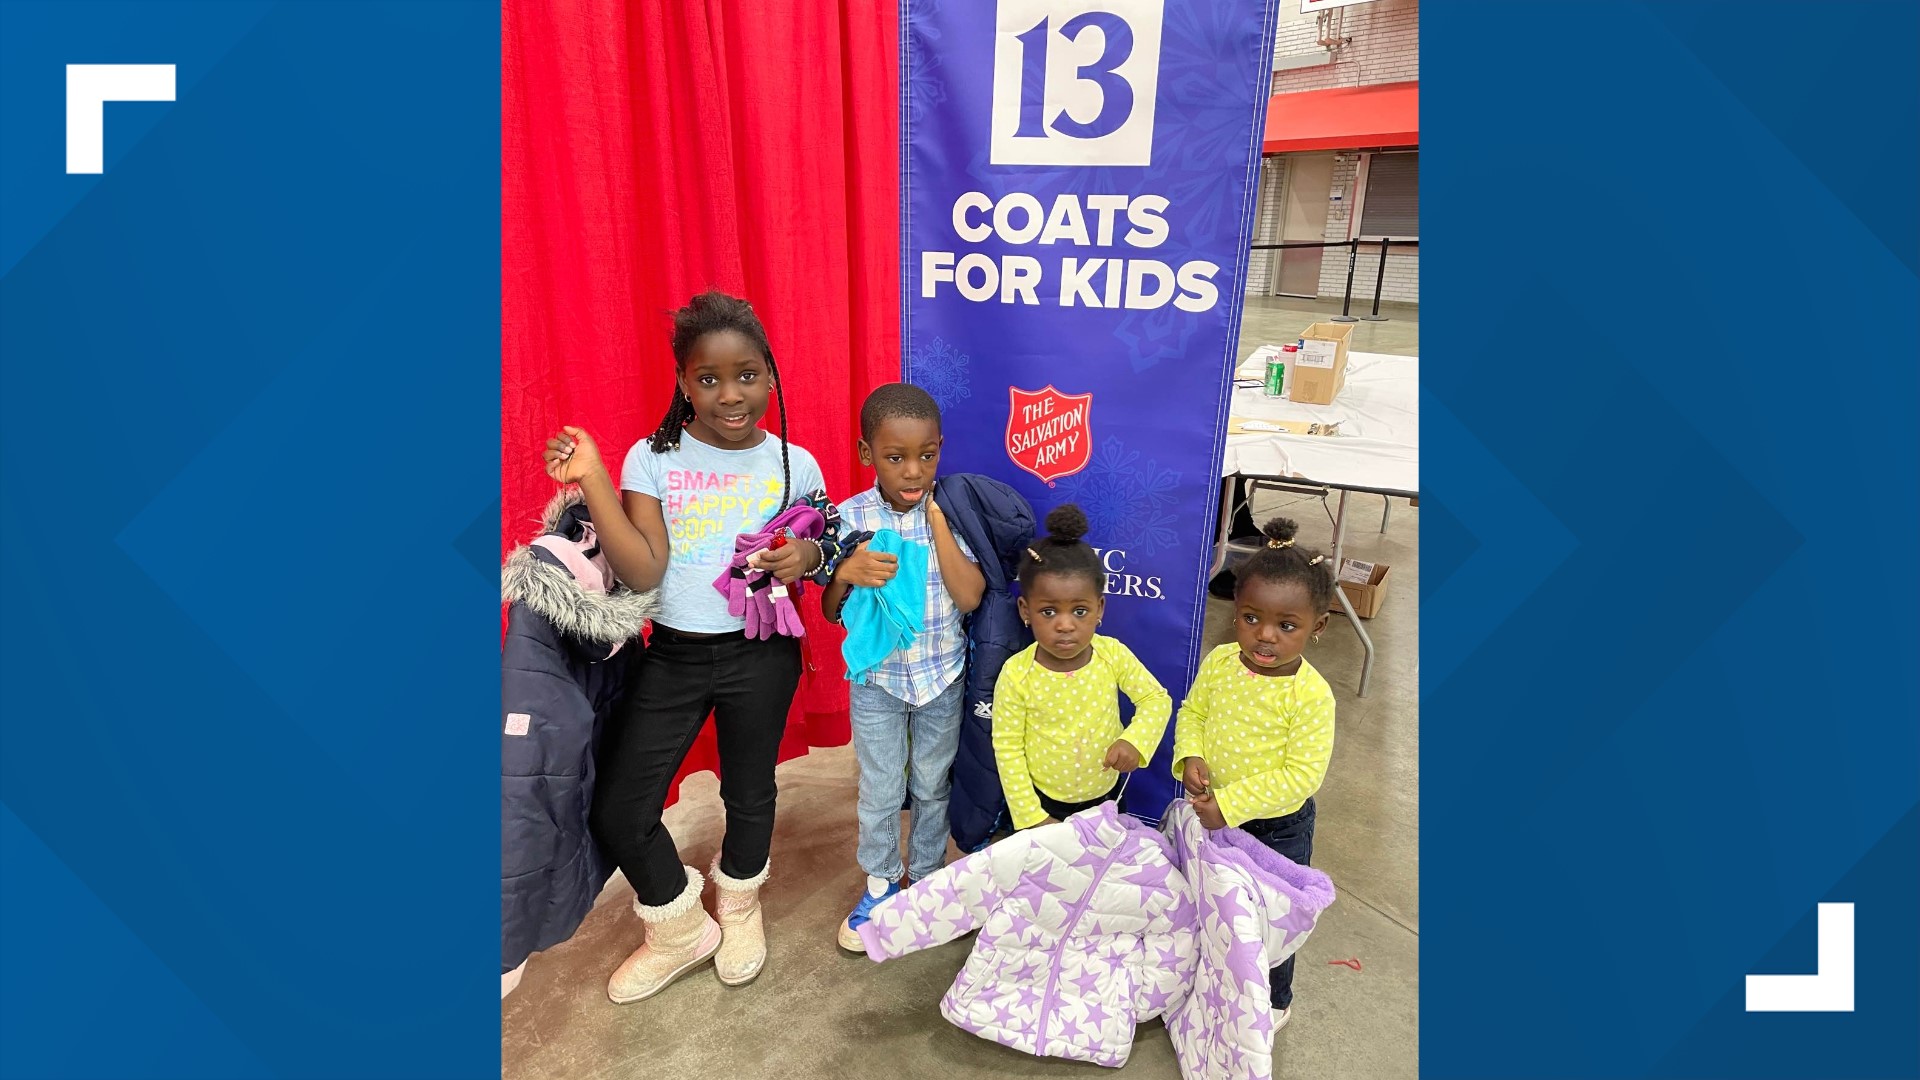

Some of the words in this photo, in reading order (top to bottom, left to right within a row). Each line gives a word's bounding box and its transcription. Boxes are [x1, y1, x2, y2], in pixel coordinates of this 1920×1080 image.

[1012, 11, 1134, 139] 13
[952, 191, 1170, 248] COATS
[921, 252, 1042, 305] FOR
[1059, 258, 1220, 313] KIDS
[1011, 403, 1083, 454] SALVATION
[1022, 396, 1055, 424] THE
[1034, 431, 1080, 469] ARMY
[667, 469, 754, 494] SMART
[667, 494, 755, 518] HAPPY
